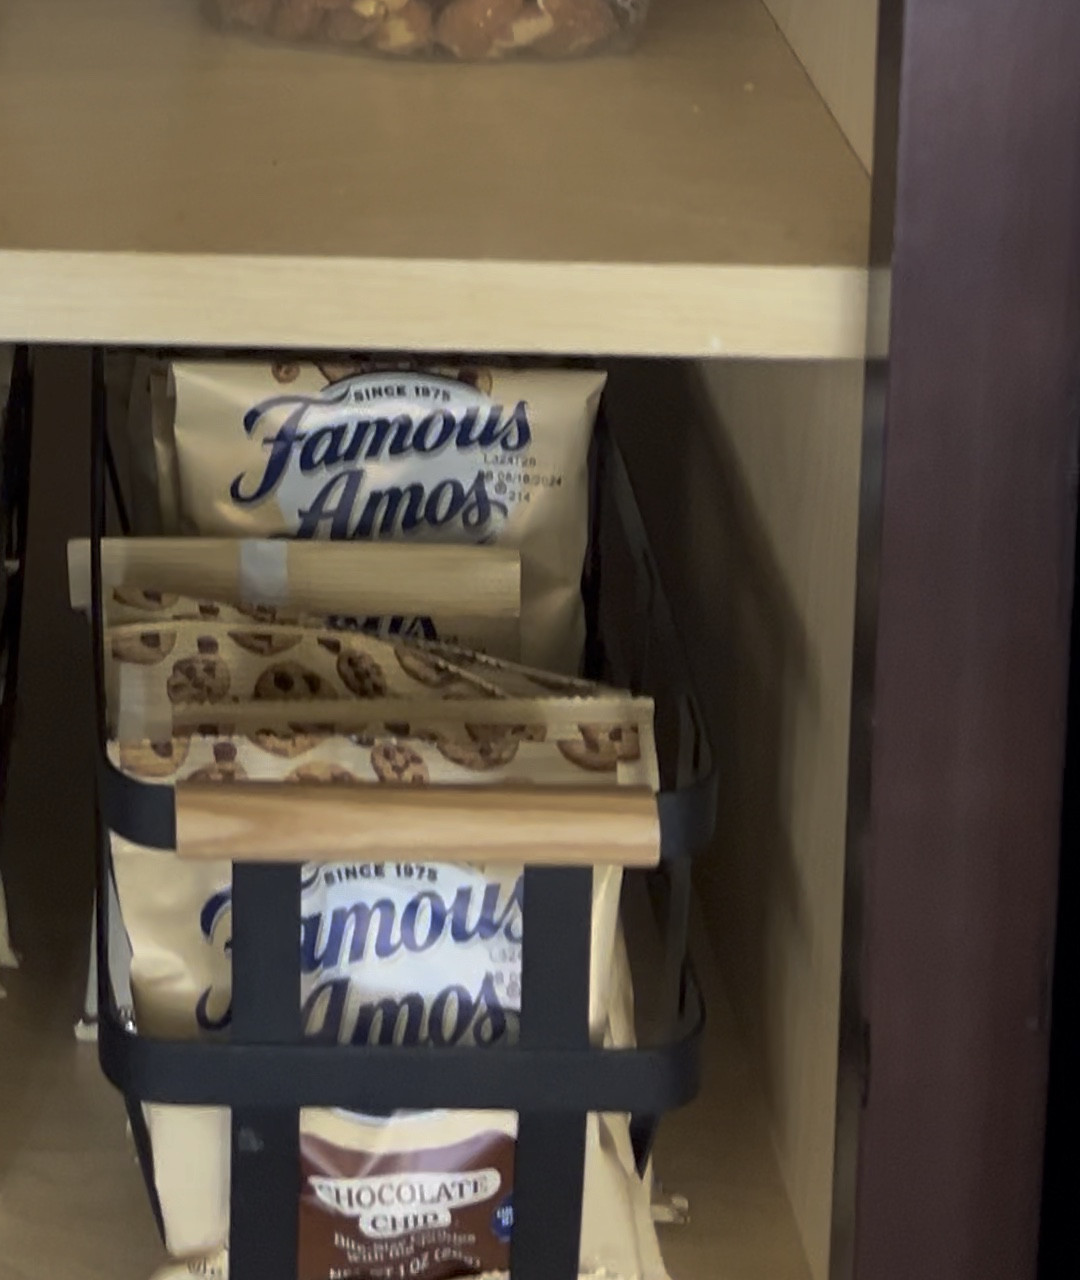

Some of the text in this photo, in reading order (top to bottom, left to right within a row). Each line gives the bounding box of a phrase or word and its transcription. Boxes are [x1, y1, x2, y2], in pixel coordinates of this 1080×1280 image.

[230, 383, 532, 507] Famous
[270, 468, 509, 543] Amos
[323, 863, 386, 885] SINCE
[370, 1212, 439, 1232] CHIP
